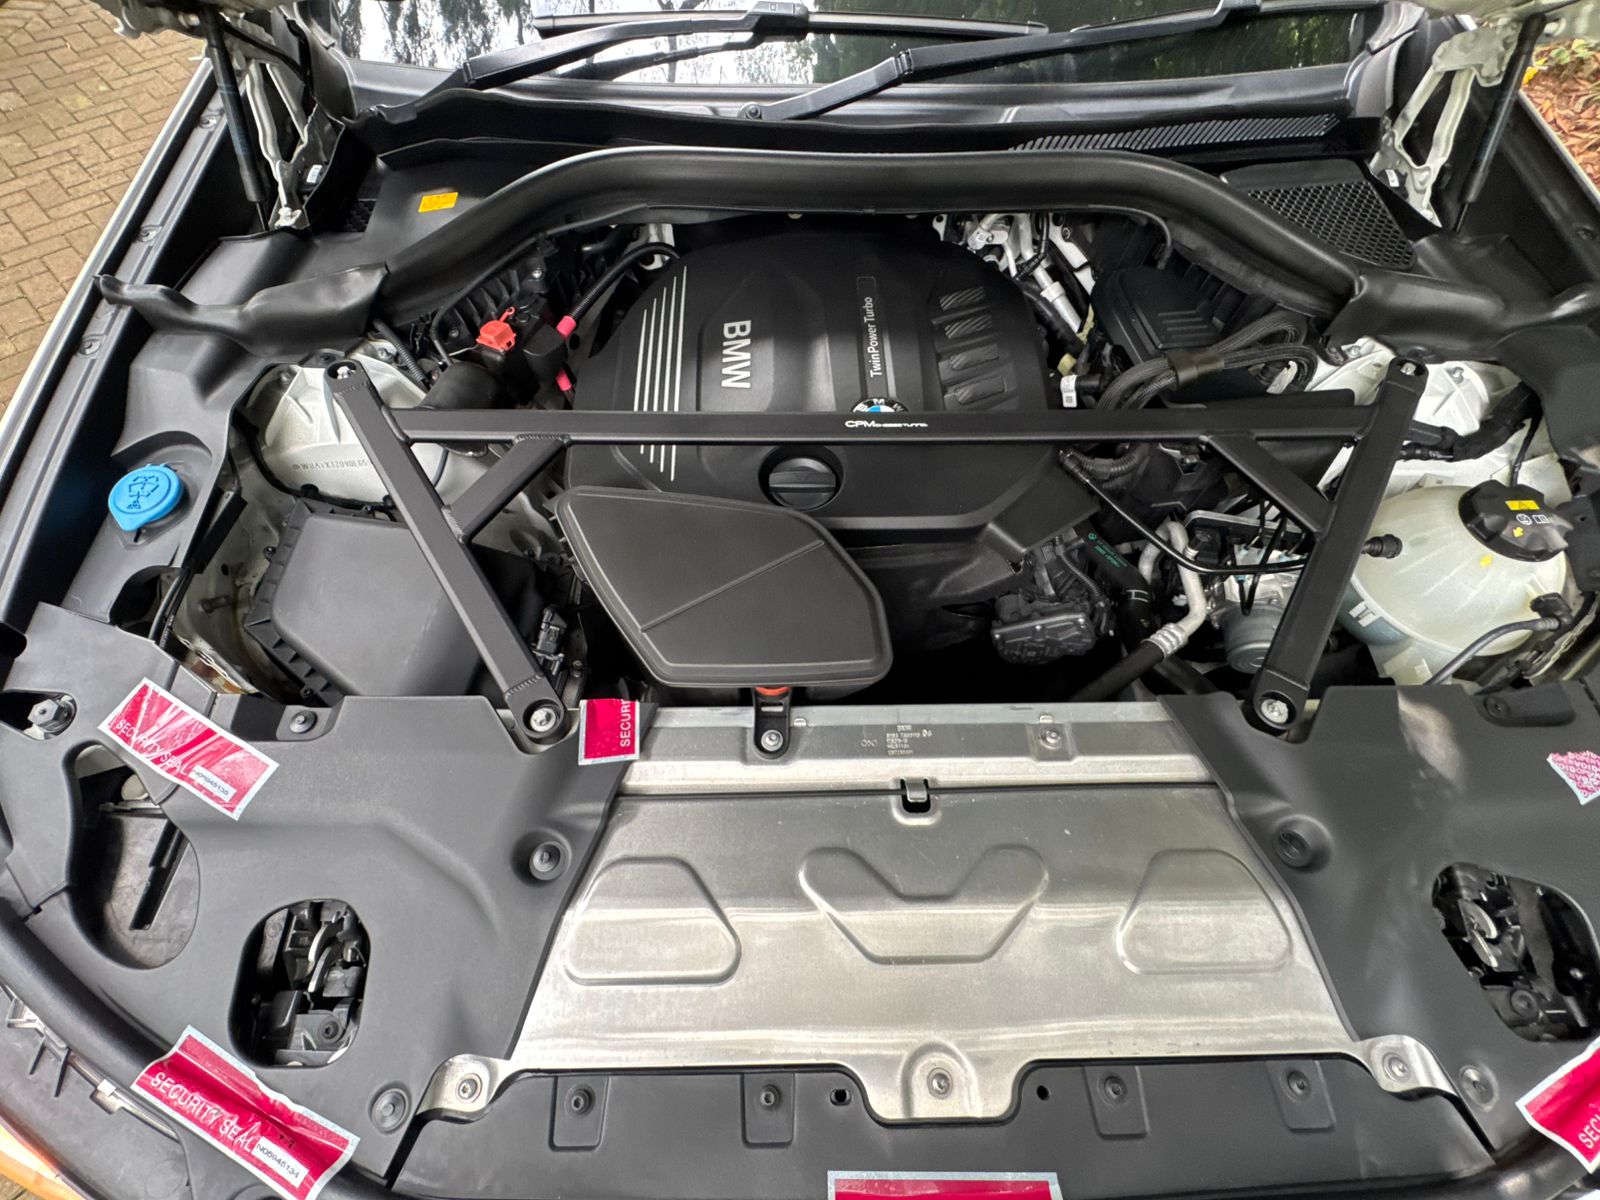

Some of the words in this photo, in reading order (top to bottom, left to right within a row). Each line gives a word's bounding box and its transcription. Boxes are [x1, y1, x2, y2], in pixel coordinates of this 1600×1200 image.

[863, 296, 876, 323] Turbo
[721, 320, 752, 389] BMW
[868, 322, 883, 378] TwinPower
[116, 719, 164, 756] SECURITY
[160, 752, 187, 776] SEAL
[151, 1072, 222, 1127] SECURITY
[219, 1118, 252, 1153] SEAL
